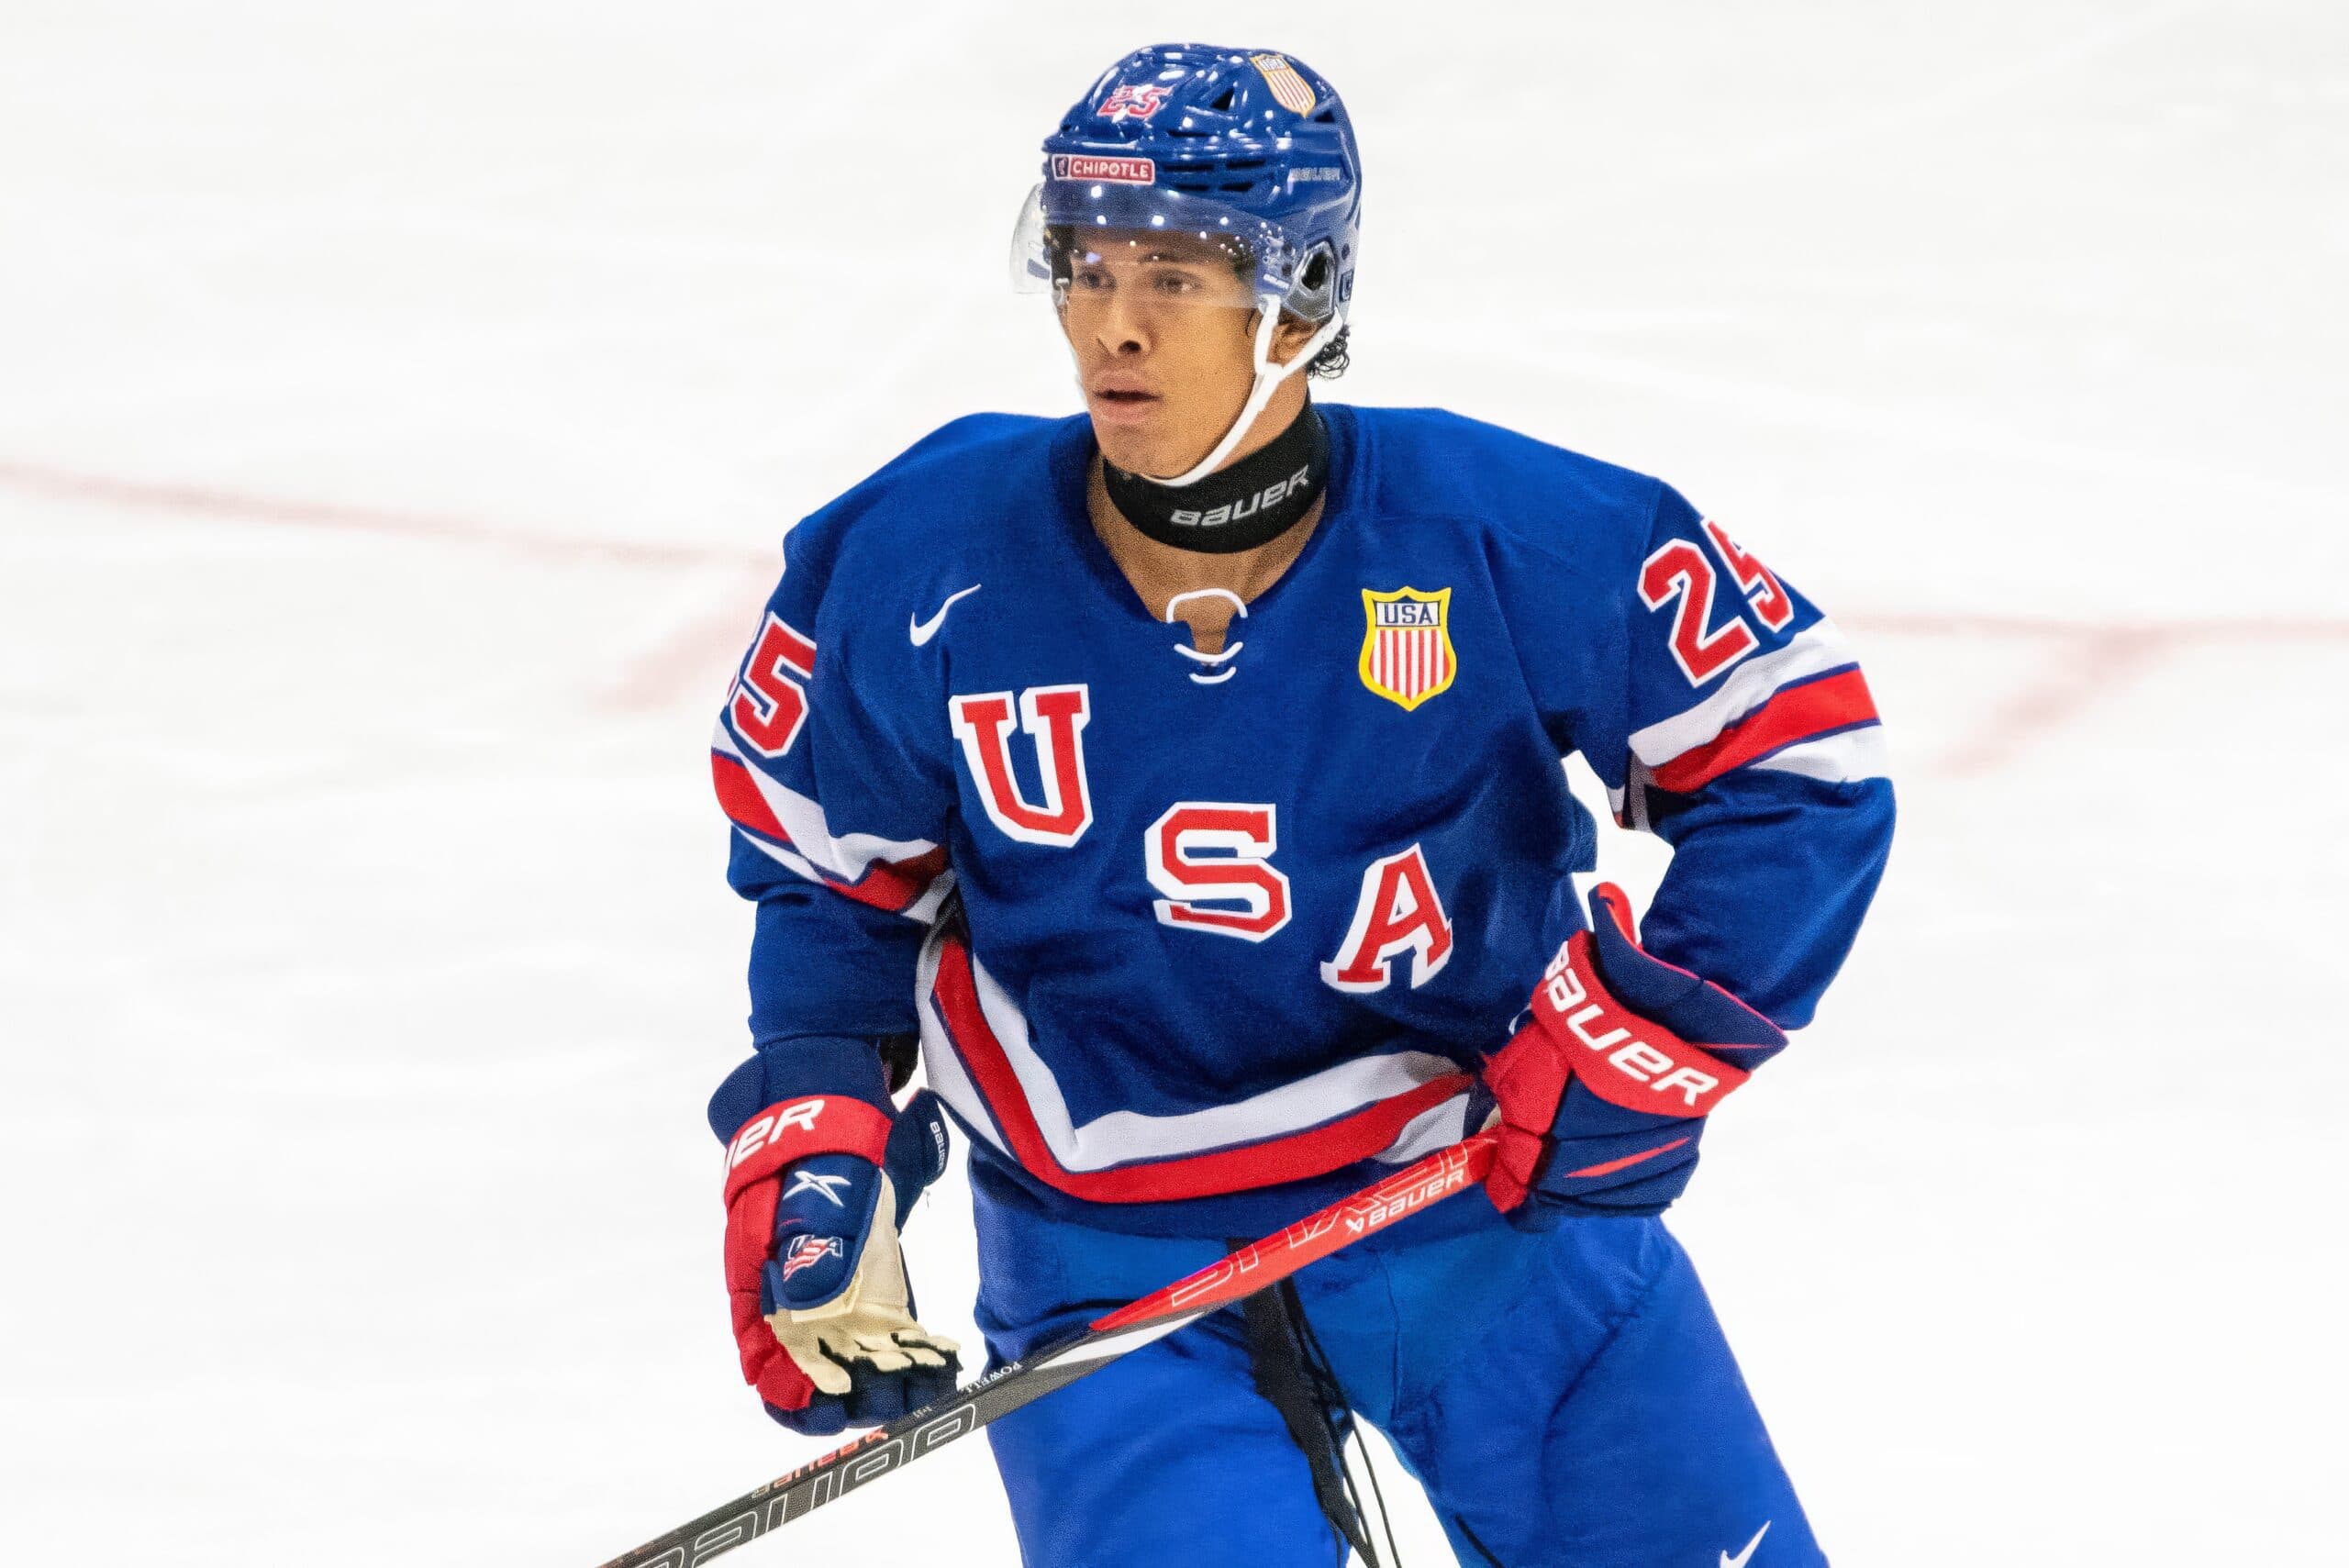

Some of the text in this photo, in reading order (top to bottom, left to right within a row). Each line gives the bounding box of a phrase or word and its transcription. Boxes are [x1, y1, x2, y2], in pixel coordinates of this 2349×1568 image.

[1096, 84, 1172, 118] 25
[1072, 160, 1150, 179] CHIPOTLE
[1170, 464, 1309, 527] BAUER
[1384, 603, 1442, 625] USA
[1636, 520, 1795, 689] 25
[727, 601, 818, 759] 5
[1367, 1169, 1465, 1229] BAUER
